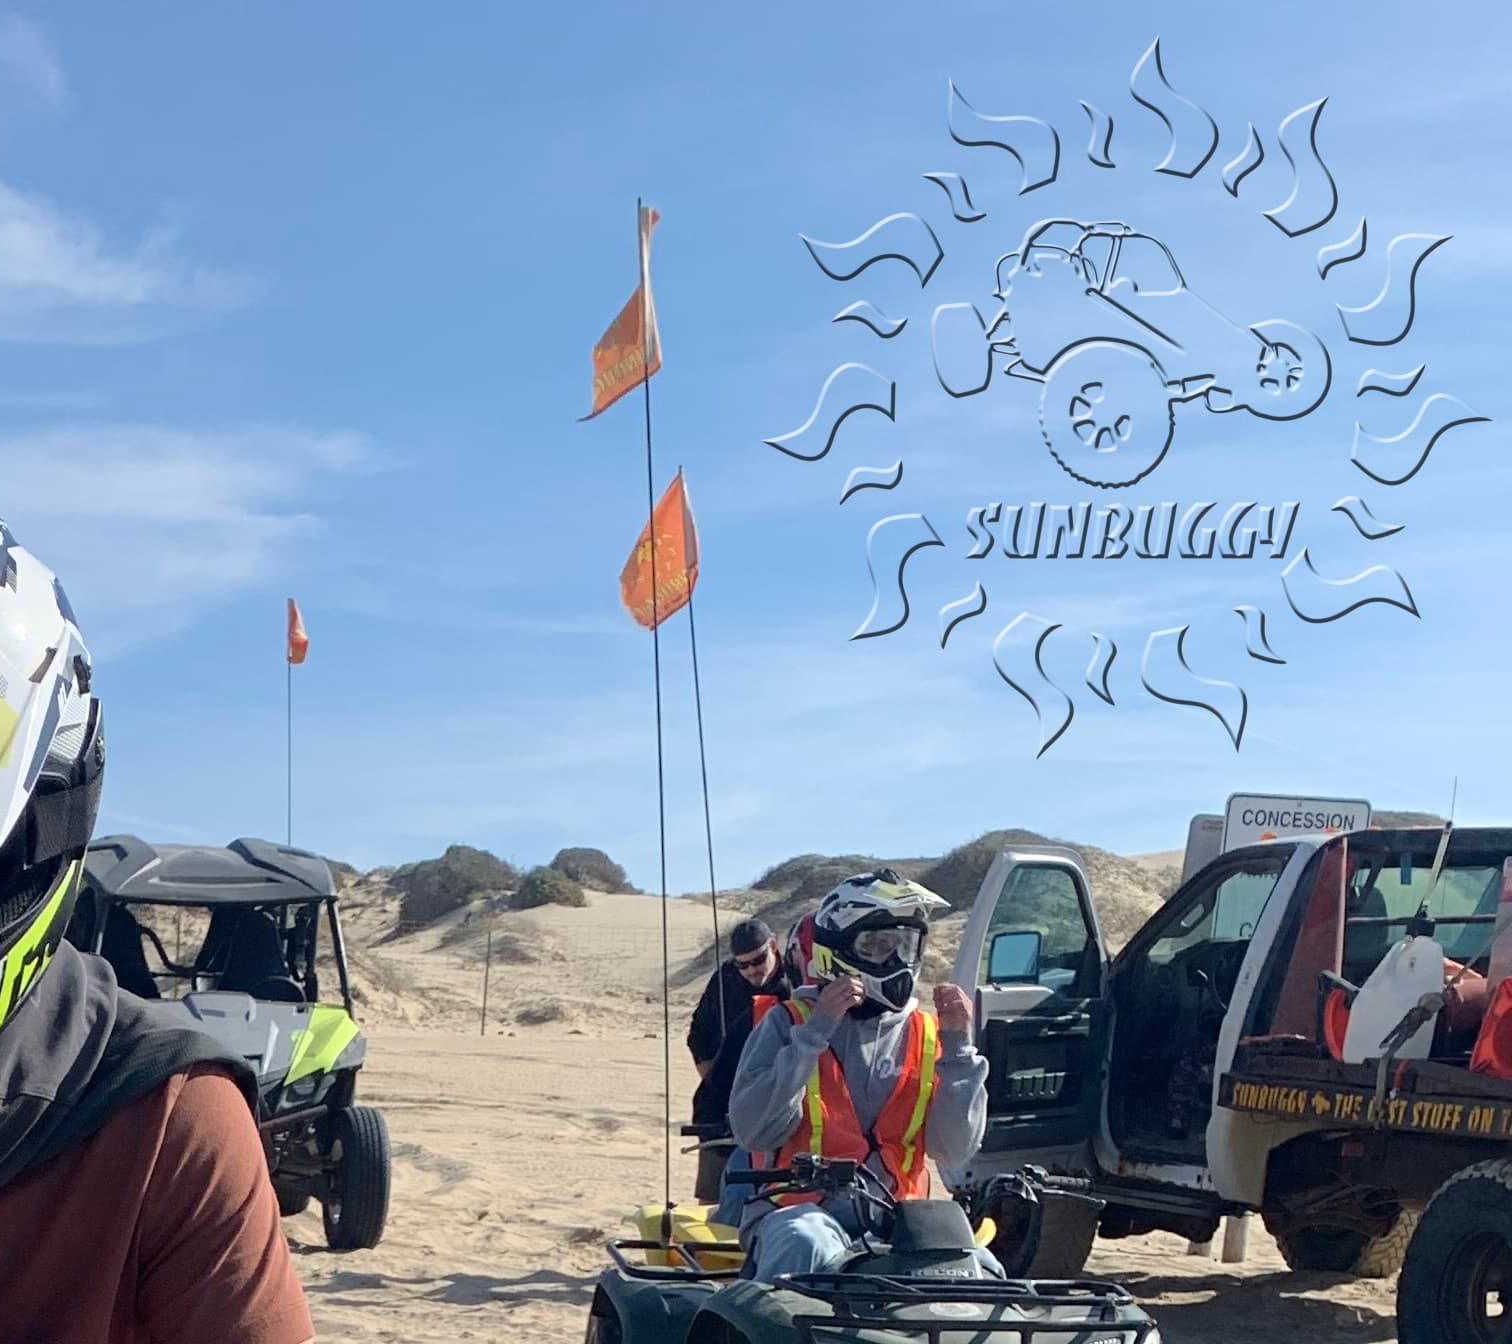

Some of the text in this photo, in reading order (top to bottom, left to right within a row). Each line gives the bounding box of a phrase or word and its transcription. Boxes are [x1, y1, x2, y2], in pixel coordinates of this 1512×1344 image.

[1241, 809, 1356, 832] CONCESSION
[1333, 1092, 1364, 1120] THE
[1411, 1101, 1465, 1132] STUFF
[1468, 1104, 1496, 1135] ON
